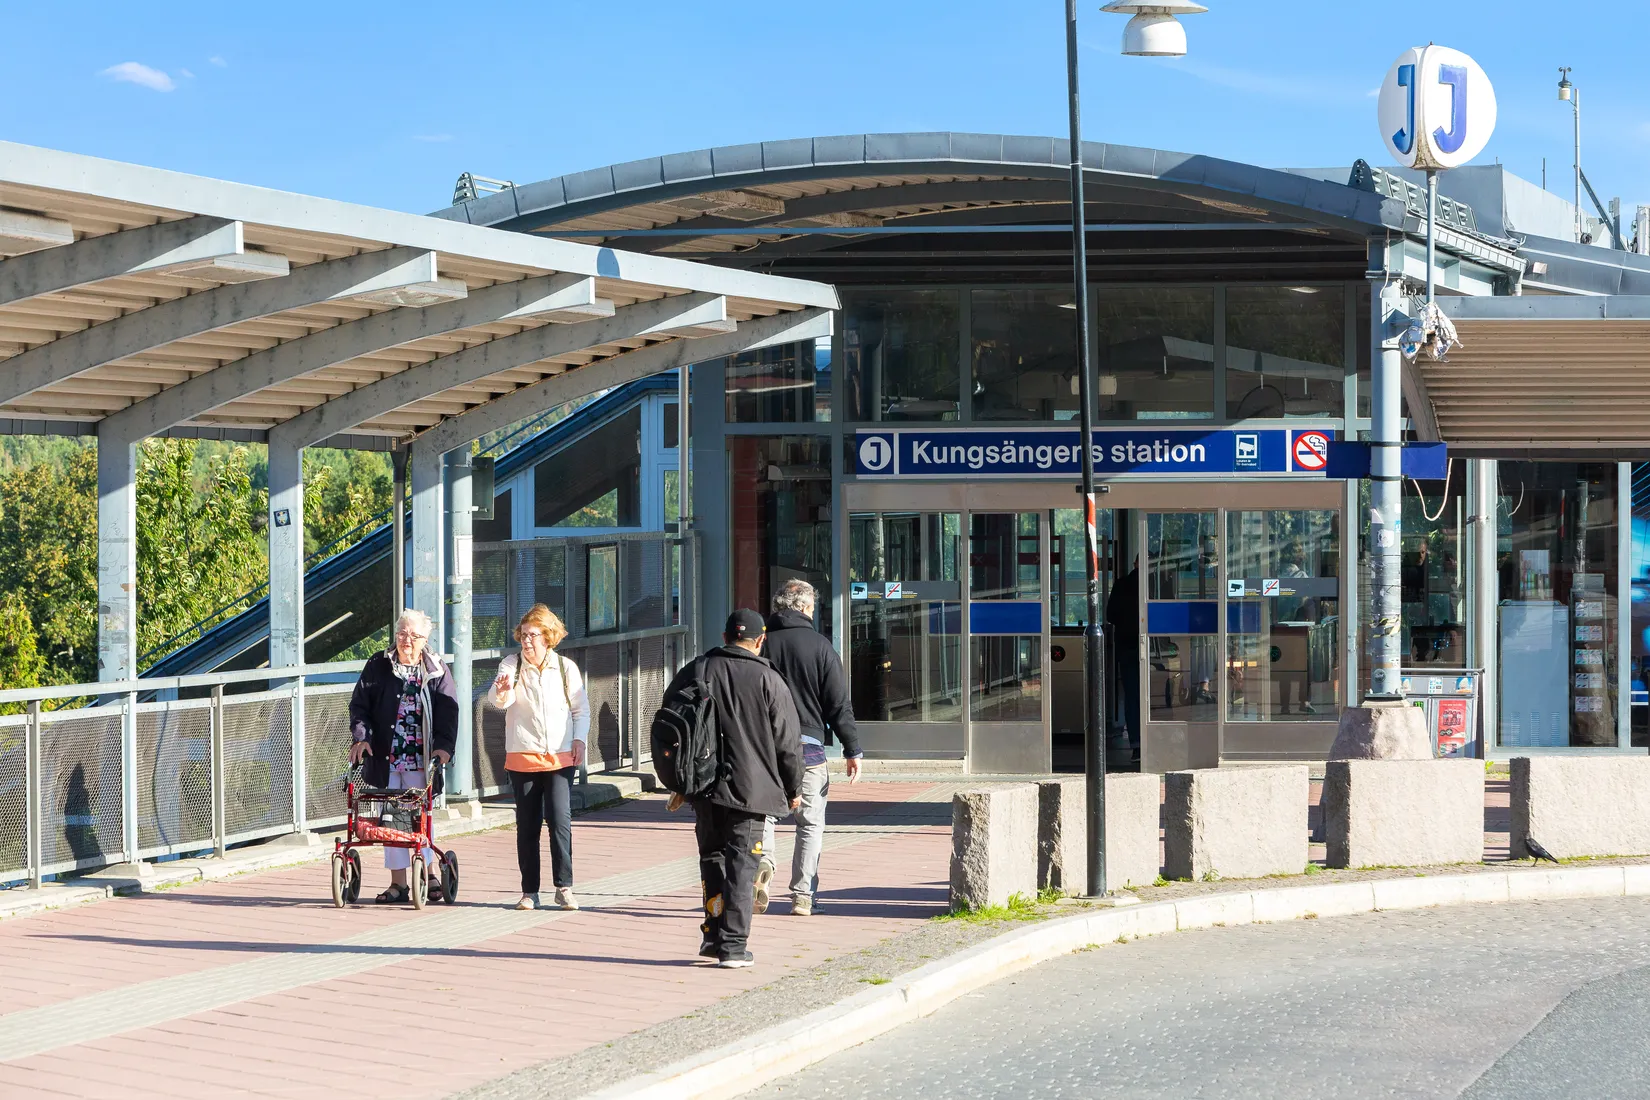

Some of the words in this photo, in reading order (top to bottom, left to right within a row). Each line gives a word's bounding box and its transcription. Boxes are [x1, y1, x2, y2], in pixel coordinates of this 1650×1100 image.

[1392, 64, 1415, 155] J
[1433, 63, 1468, 154] J
[868, 442, 881, 467] J
[1111, 440, 1206, 462] station
